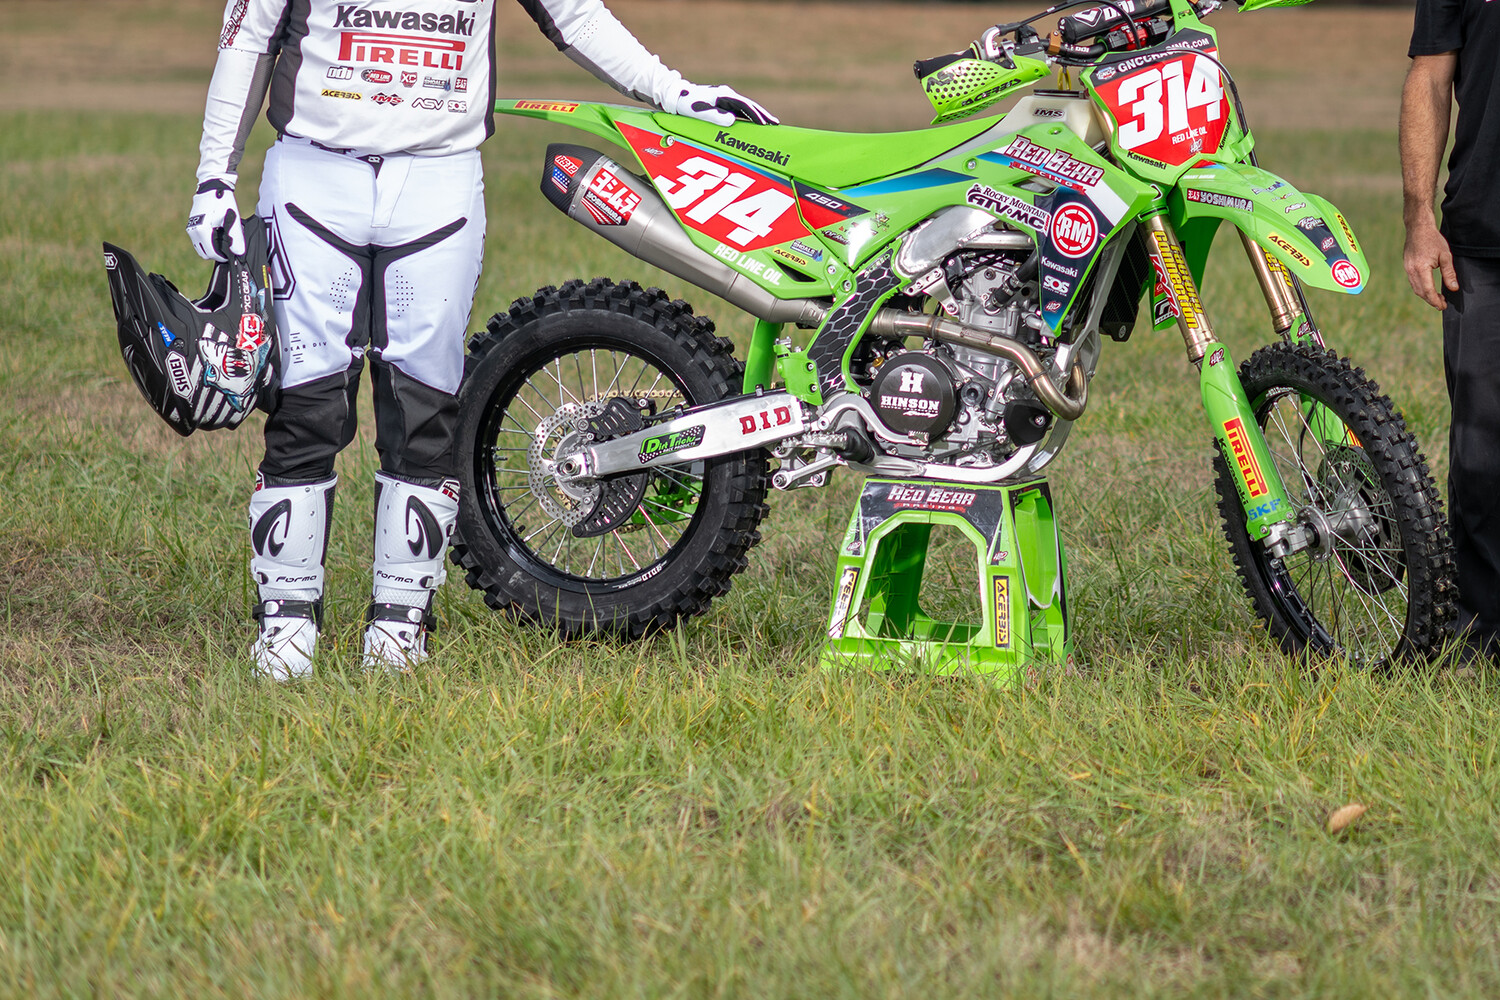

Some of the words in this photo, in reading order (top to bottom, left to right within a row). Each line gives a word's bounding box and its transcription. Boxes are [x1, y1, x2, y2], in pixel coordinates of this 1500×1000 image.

[333, 5, 475, 37] Kawasaki
[338, 32, 466, 71] PIRELLI
[322, 90, 361, 100] ACERBIS
[372, 95, 403, 104] IMS
[411, 98, 444, 110] ASV
[962, 78, 1022, 107] ACERBIS
[1118, 50, 1224, 151] 314
[448, 100, 467, 111] SOS
[515, 101, 579, 113] PIRELLI
[1034, 108, 1065, 118] IMS
[714, 130, 790, 167] Kawasaki
[1171, 132, 1187, 145] RED
[1003, 134, 1051, 166] RED
[1042, 148, 1105, 187] BEAR
[1127, 151, 1167, 170] Kawasaki
[1019, 162, 1073, 187] RACING
[584, 190, 623, 225] YOSHIMURA
[652, 156, 796, 247] 314
[982, 186, 1010, 203] ROCKY
[1009, 197, 1046, 219] MOUNTAIN
[1199, 191, 1254, 213] YOSHIMURA
[774, 249, 806, 266] ACERBIS
[1268, 235, 1311, 266] ACERBIS
[712, 244, 741, 261] RED
[736, 254, 763, 275] LINE
[762, 267, 784, 286] OIL
[1041, 256, 1078, 278] Kawasaki
[1044, 275, 1070, 294] SOS
[169, 358, 191, 393] SHOEI
[880, 395, 940, 410] HINSON
[739, 406, 791, 435] D.I.D
[646, 438, 669, 454] Dirt
[669, 432, 697, 448] Tricks
[1224, 417, 1268, 498] PIRELLI
[1218, 438, 1249, 506] Kawasaki
[887, 486, 927, 503] RED
[926, 487, 977, 506] BEAR
[1248, 498, 1281, 521] SKF
[996, 580, 1008, 643] ACERBIS
